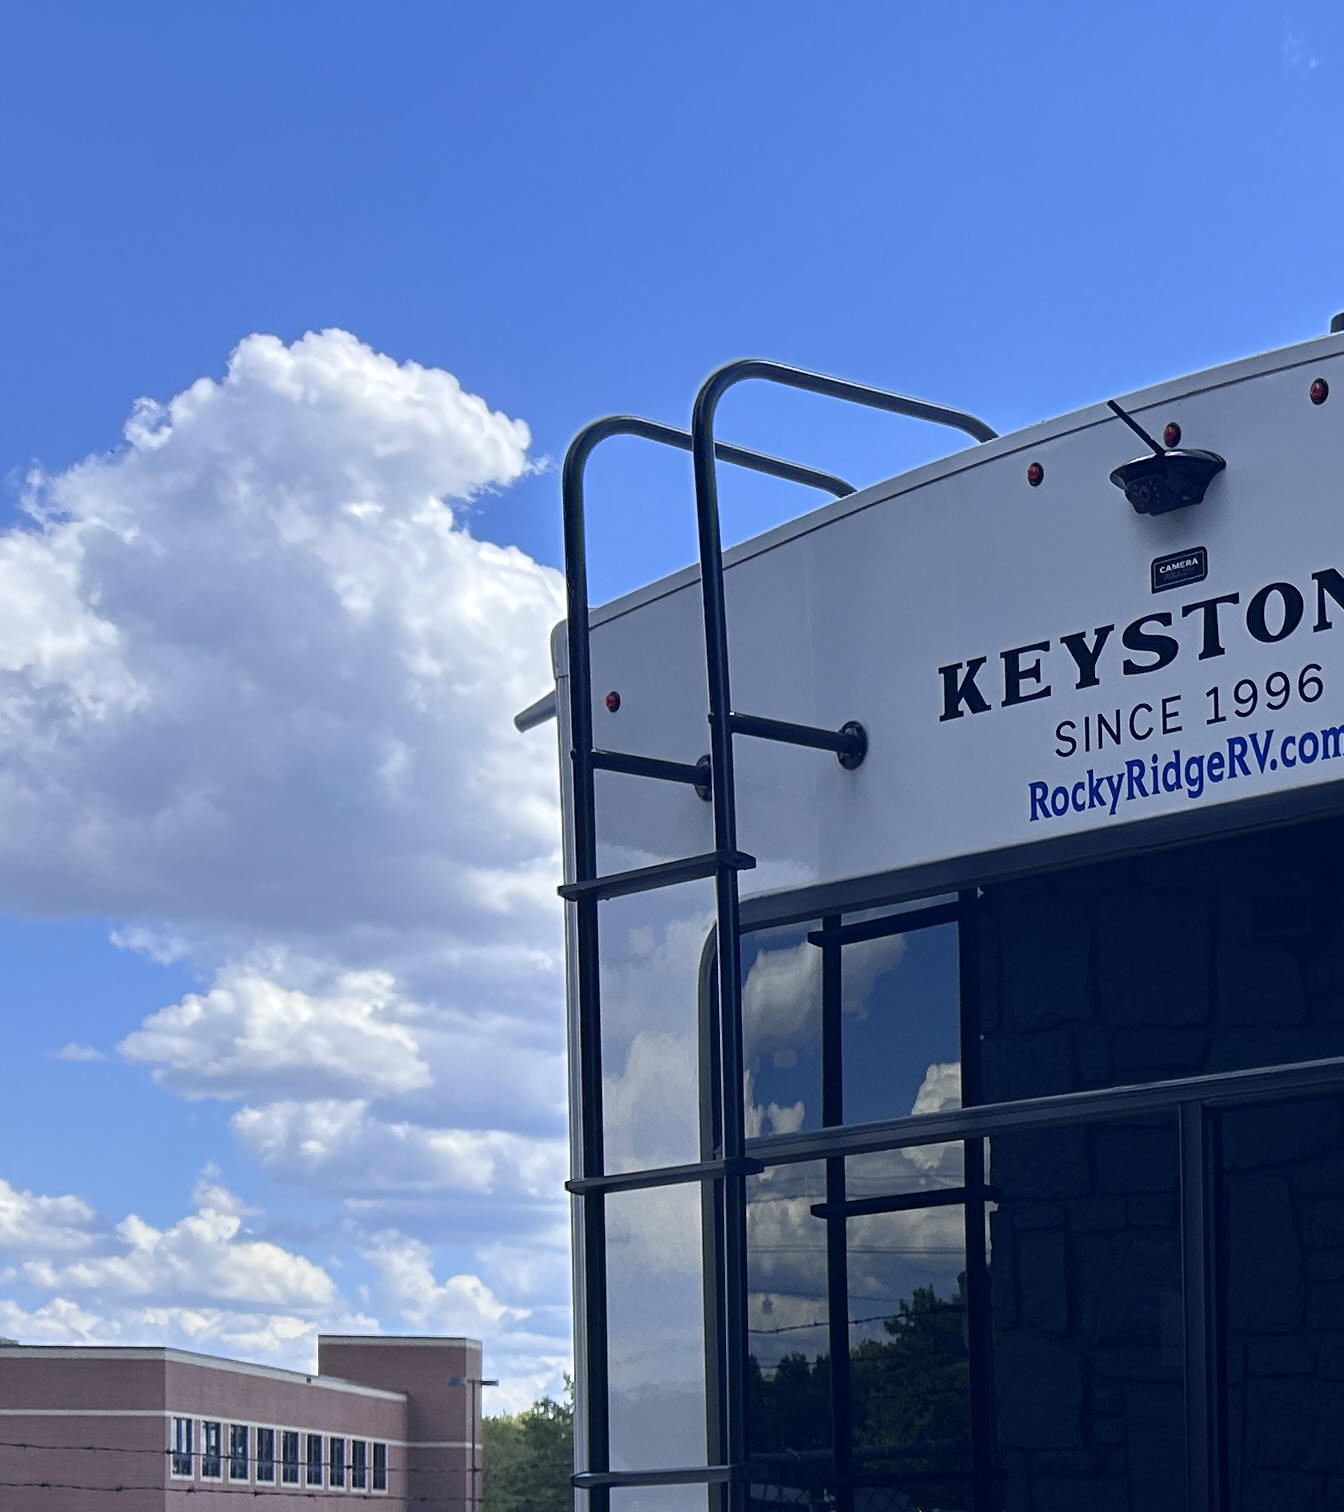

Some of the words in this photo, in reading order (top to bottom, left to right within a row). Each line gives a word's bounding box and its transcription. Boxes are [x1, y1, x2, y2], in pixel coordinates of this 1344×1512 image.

[1159, 557, 1199, 574] CAMERA
[1054, 695, 1183, 759] SINCE
[1205, 662, 1325, 726] 1996
